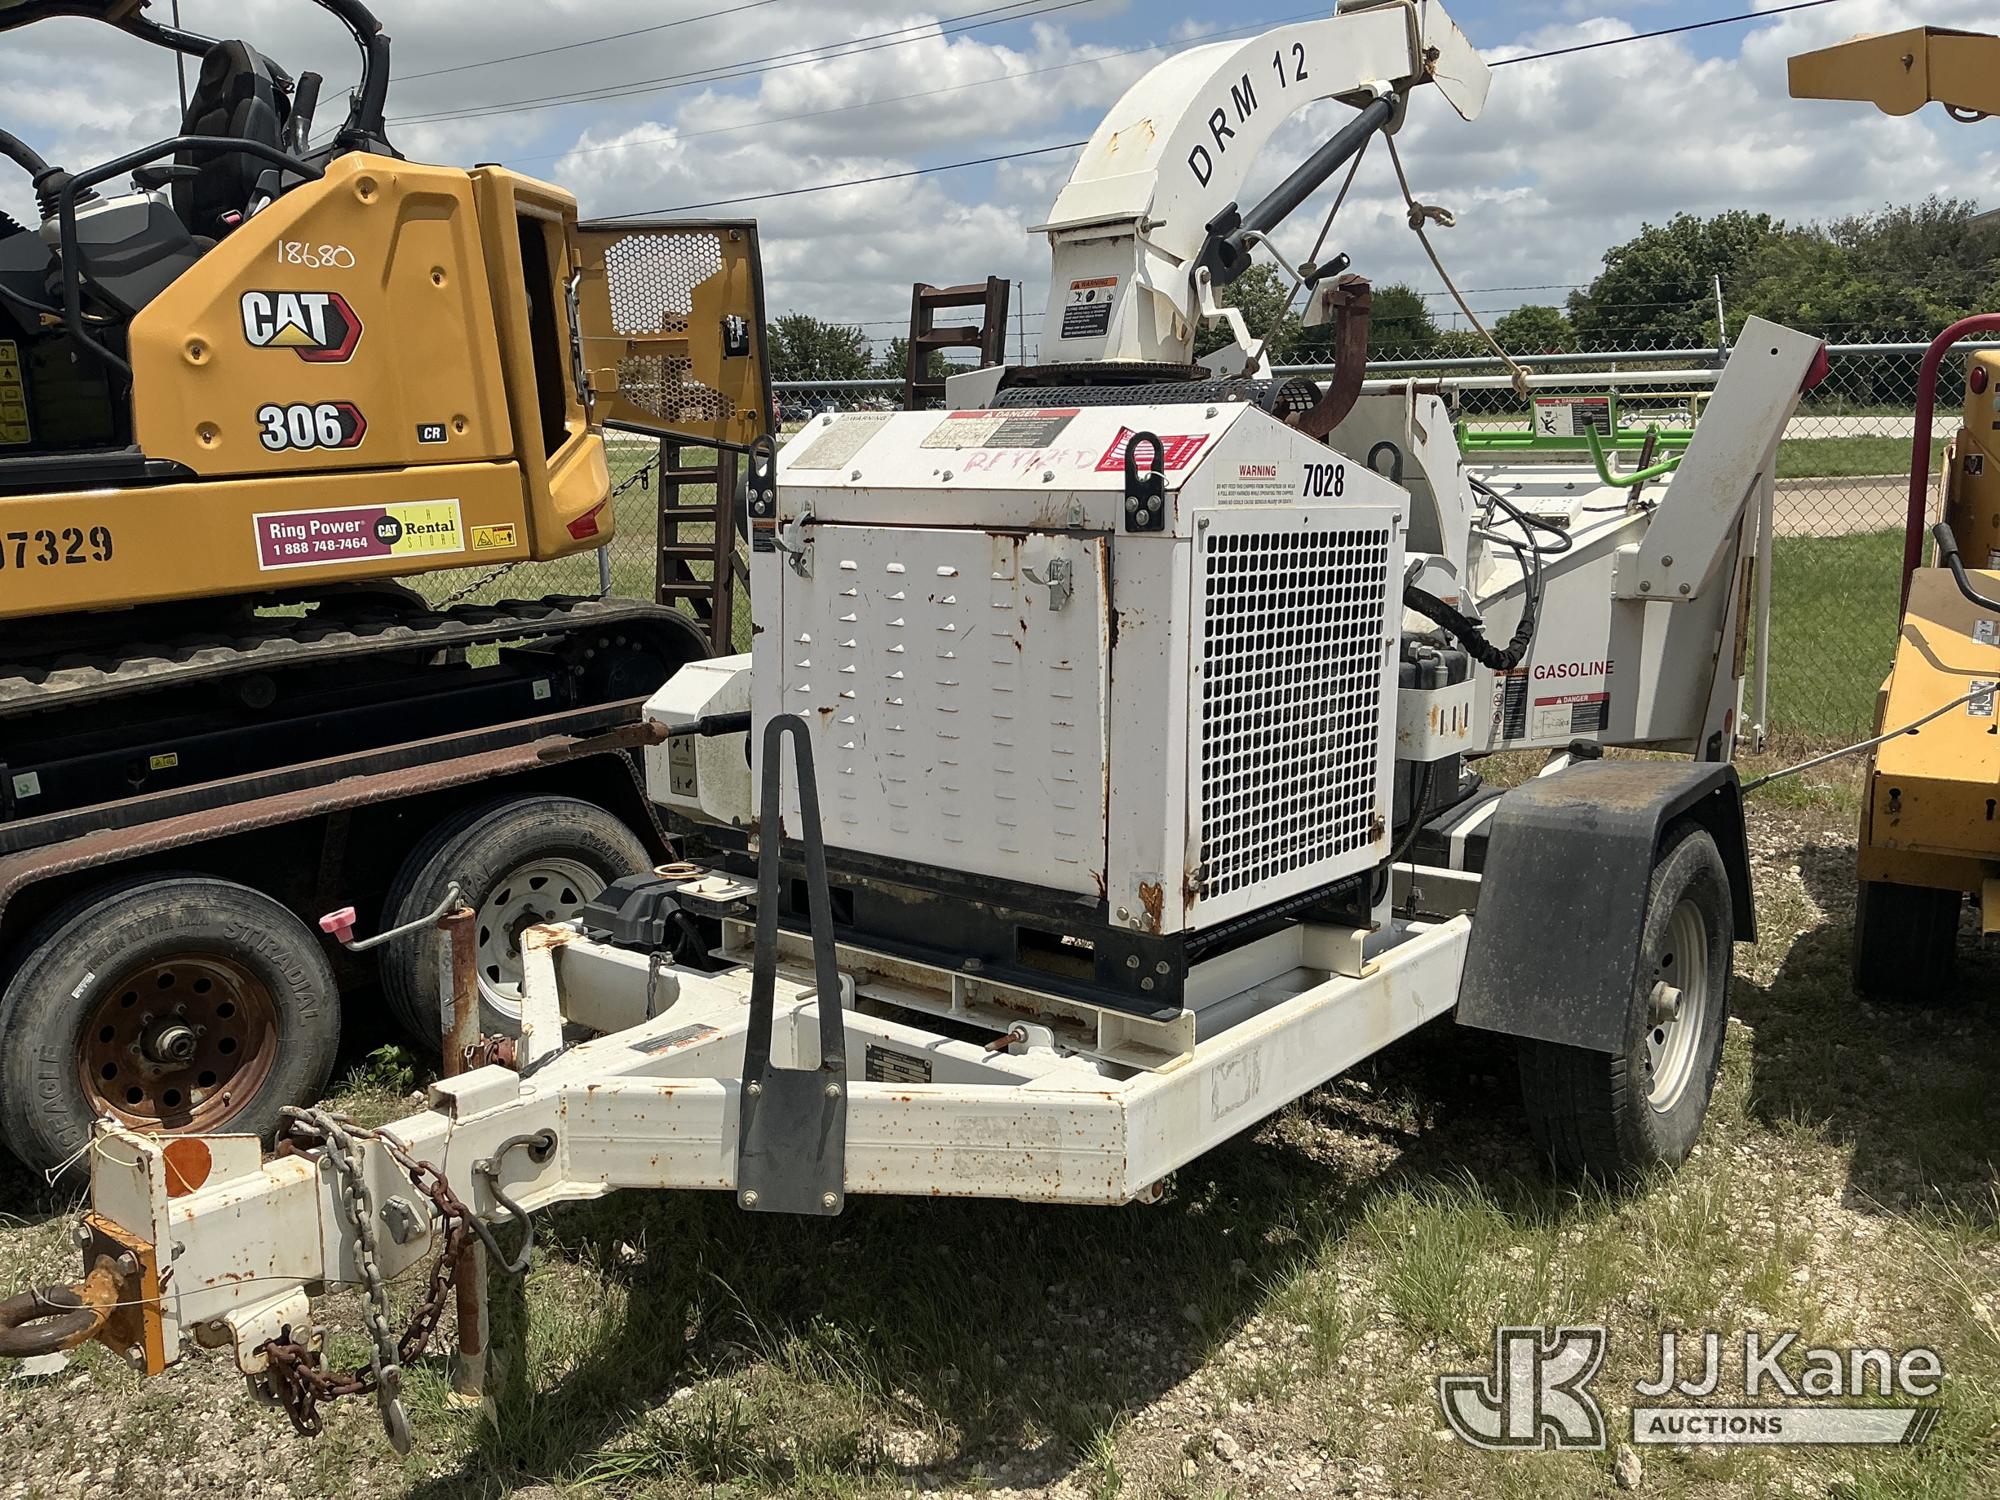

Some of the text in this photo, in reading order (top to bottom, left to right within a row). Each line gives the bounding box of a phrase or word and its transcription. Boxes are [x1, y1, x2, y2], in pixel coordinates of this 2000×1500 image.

[1187, 42, 1310, 189] DRM 12
[277, 239, 356, 269] 18680
[241, 291, 330, 346] CAT
[258, 404, 343, 450] 306
[423, 426, 441, 440] CR
[1239, 465, 1276, 477] WARNING
[1302, 463, 1345, 497] 7028
[403, 507, 453, 521] THE
[269, 521, 309, 540] Ring
[377, 523, 398, 538] CAT
[405, 520, 455, 535] Rental
[0, 526, 113, 570] 7329
[273, 537, 369, 556] 1 888 748-7464
[407, 533, 457, 548] STORE
[1534, 660, 1615, 680] GASOLINE
[1563, 694, 1589, 704] DANGER
